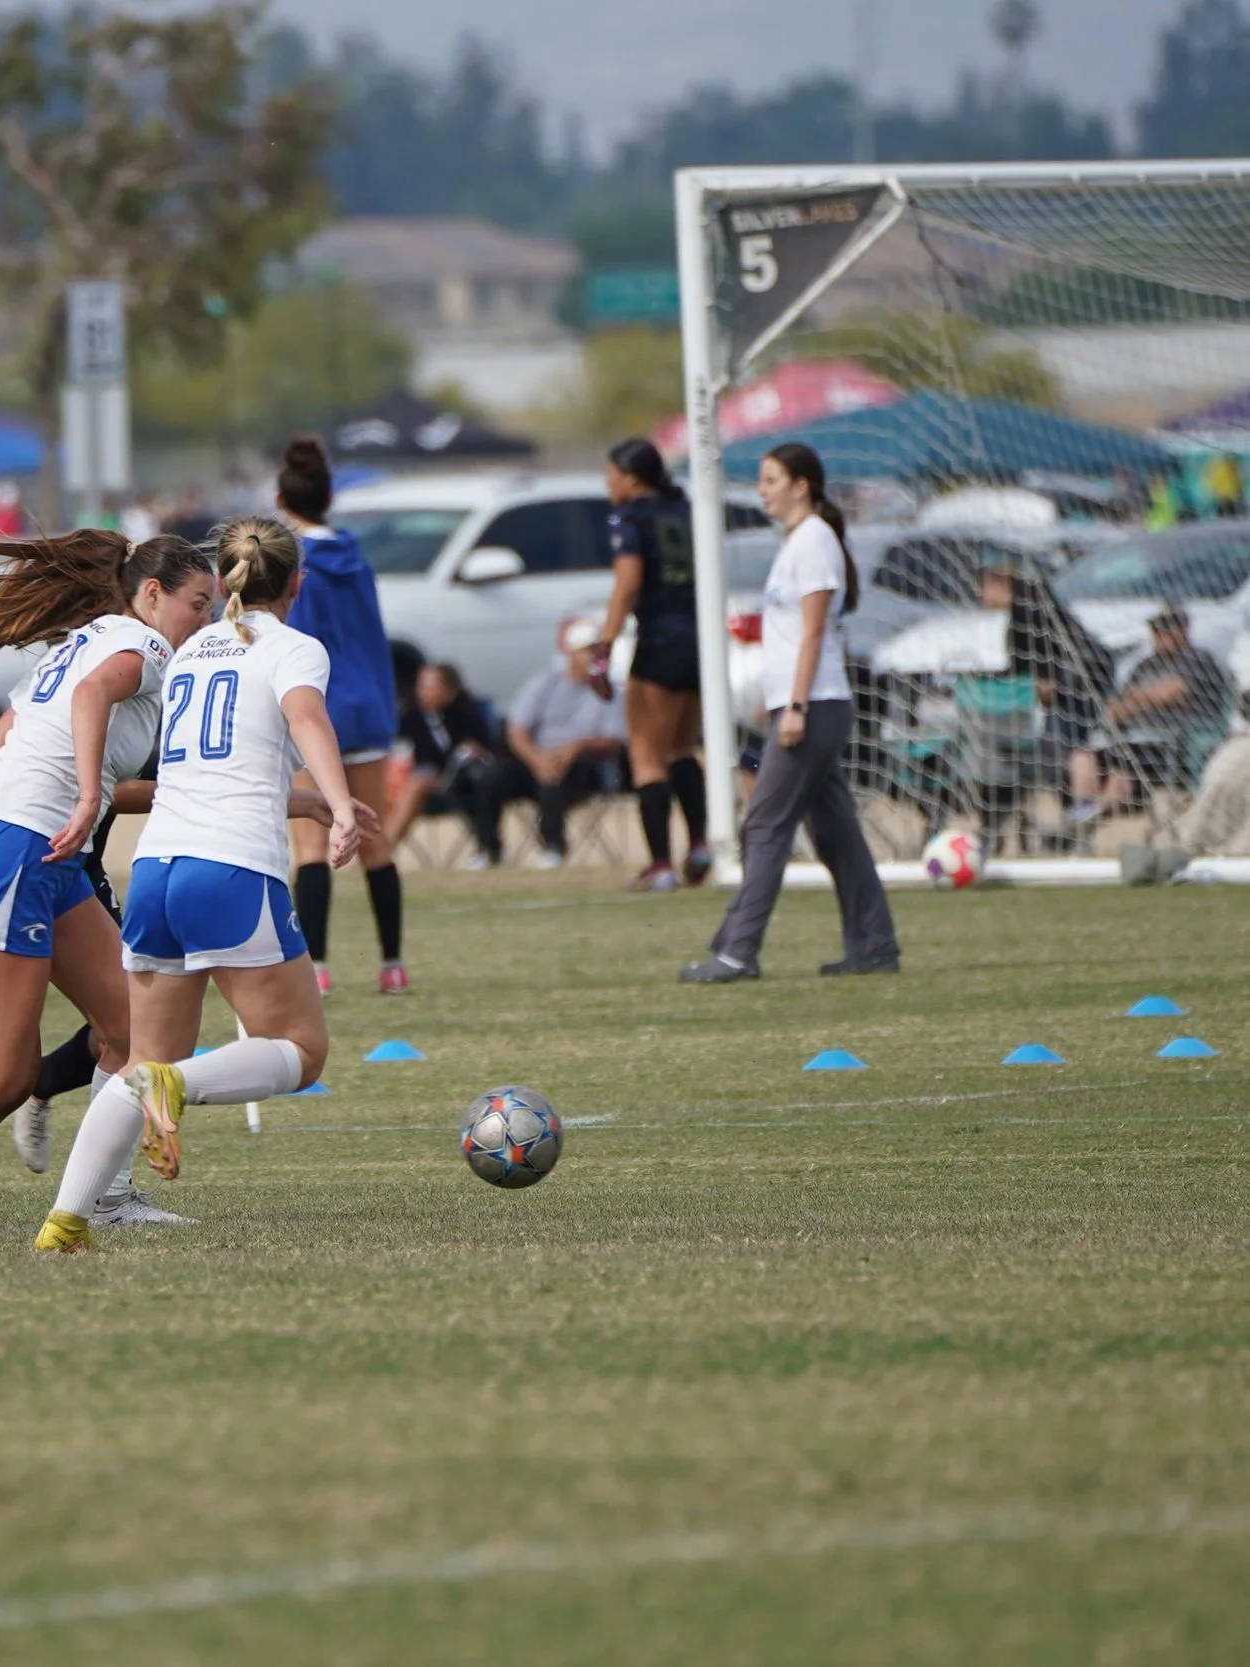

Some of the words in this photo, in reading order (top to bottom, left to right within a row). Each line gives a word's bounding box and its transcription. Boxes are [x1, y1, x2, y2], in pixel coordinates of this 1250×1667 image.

[740, 233, 779, 293] 5
[194, 647, 248, 660] ANGELES
[162, 669, 239, 765] 20
